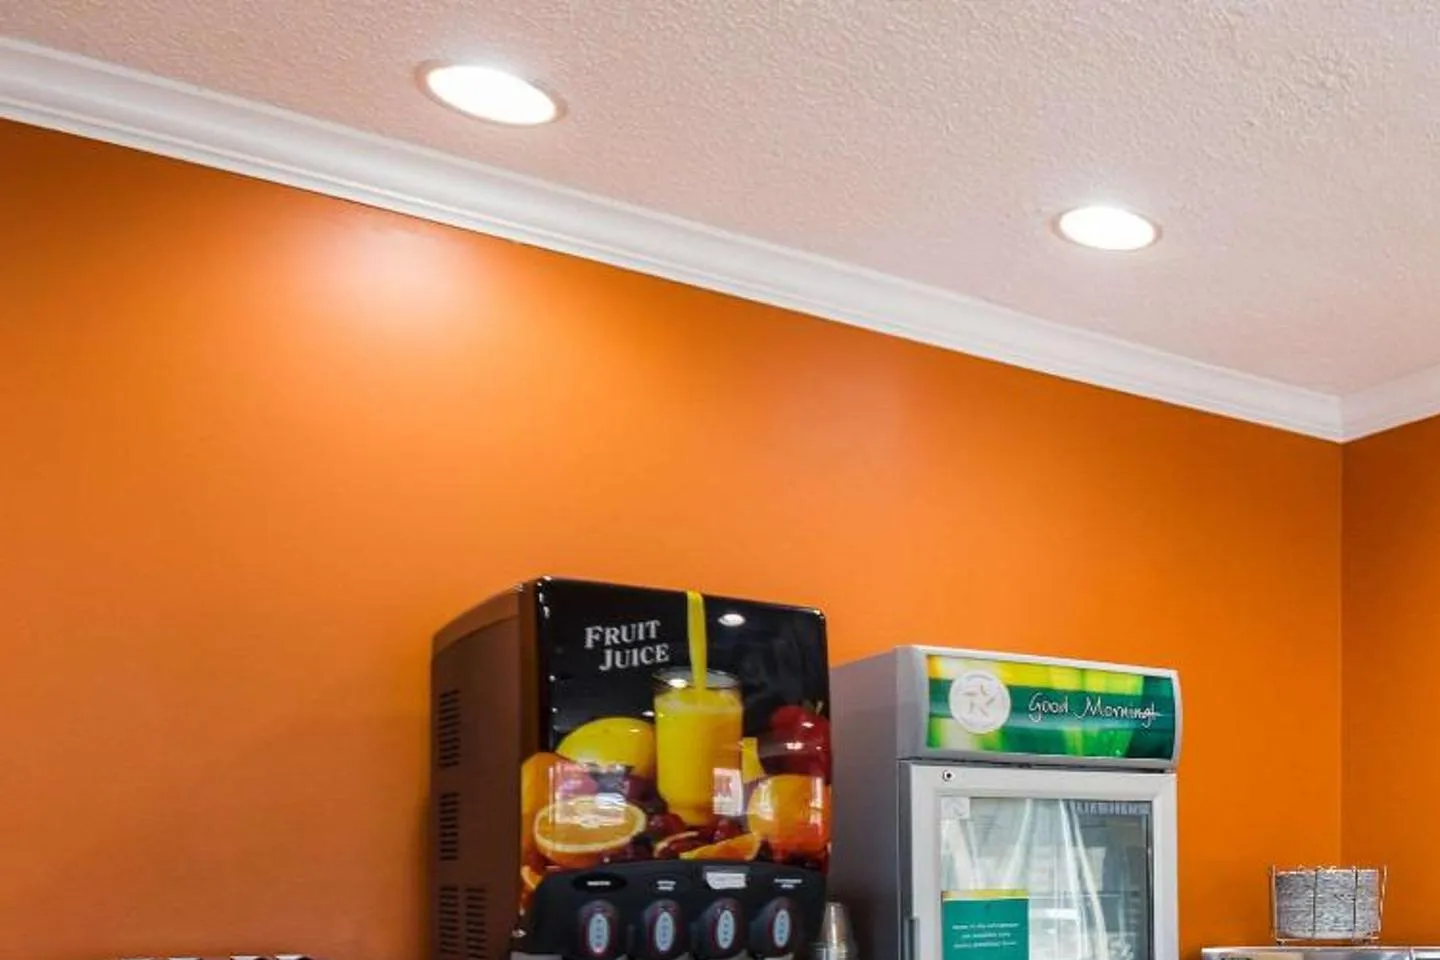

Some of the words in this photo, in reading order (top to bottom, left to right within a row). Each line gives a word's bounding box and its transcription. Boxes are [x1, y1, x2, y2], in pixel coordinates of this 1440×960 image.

[584, 620, 660, 649] FRUIT
[599, 643, 669, 670] JUICE
[1028, 692, 1068, 723] Good
